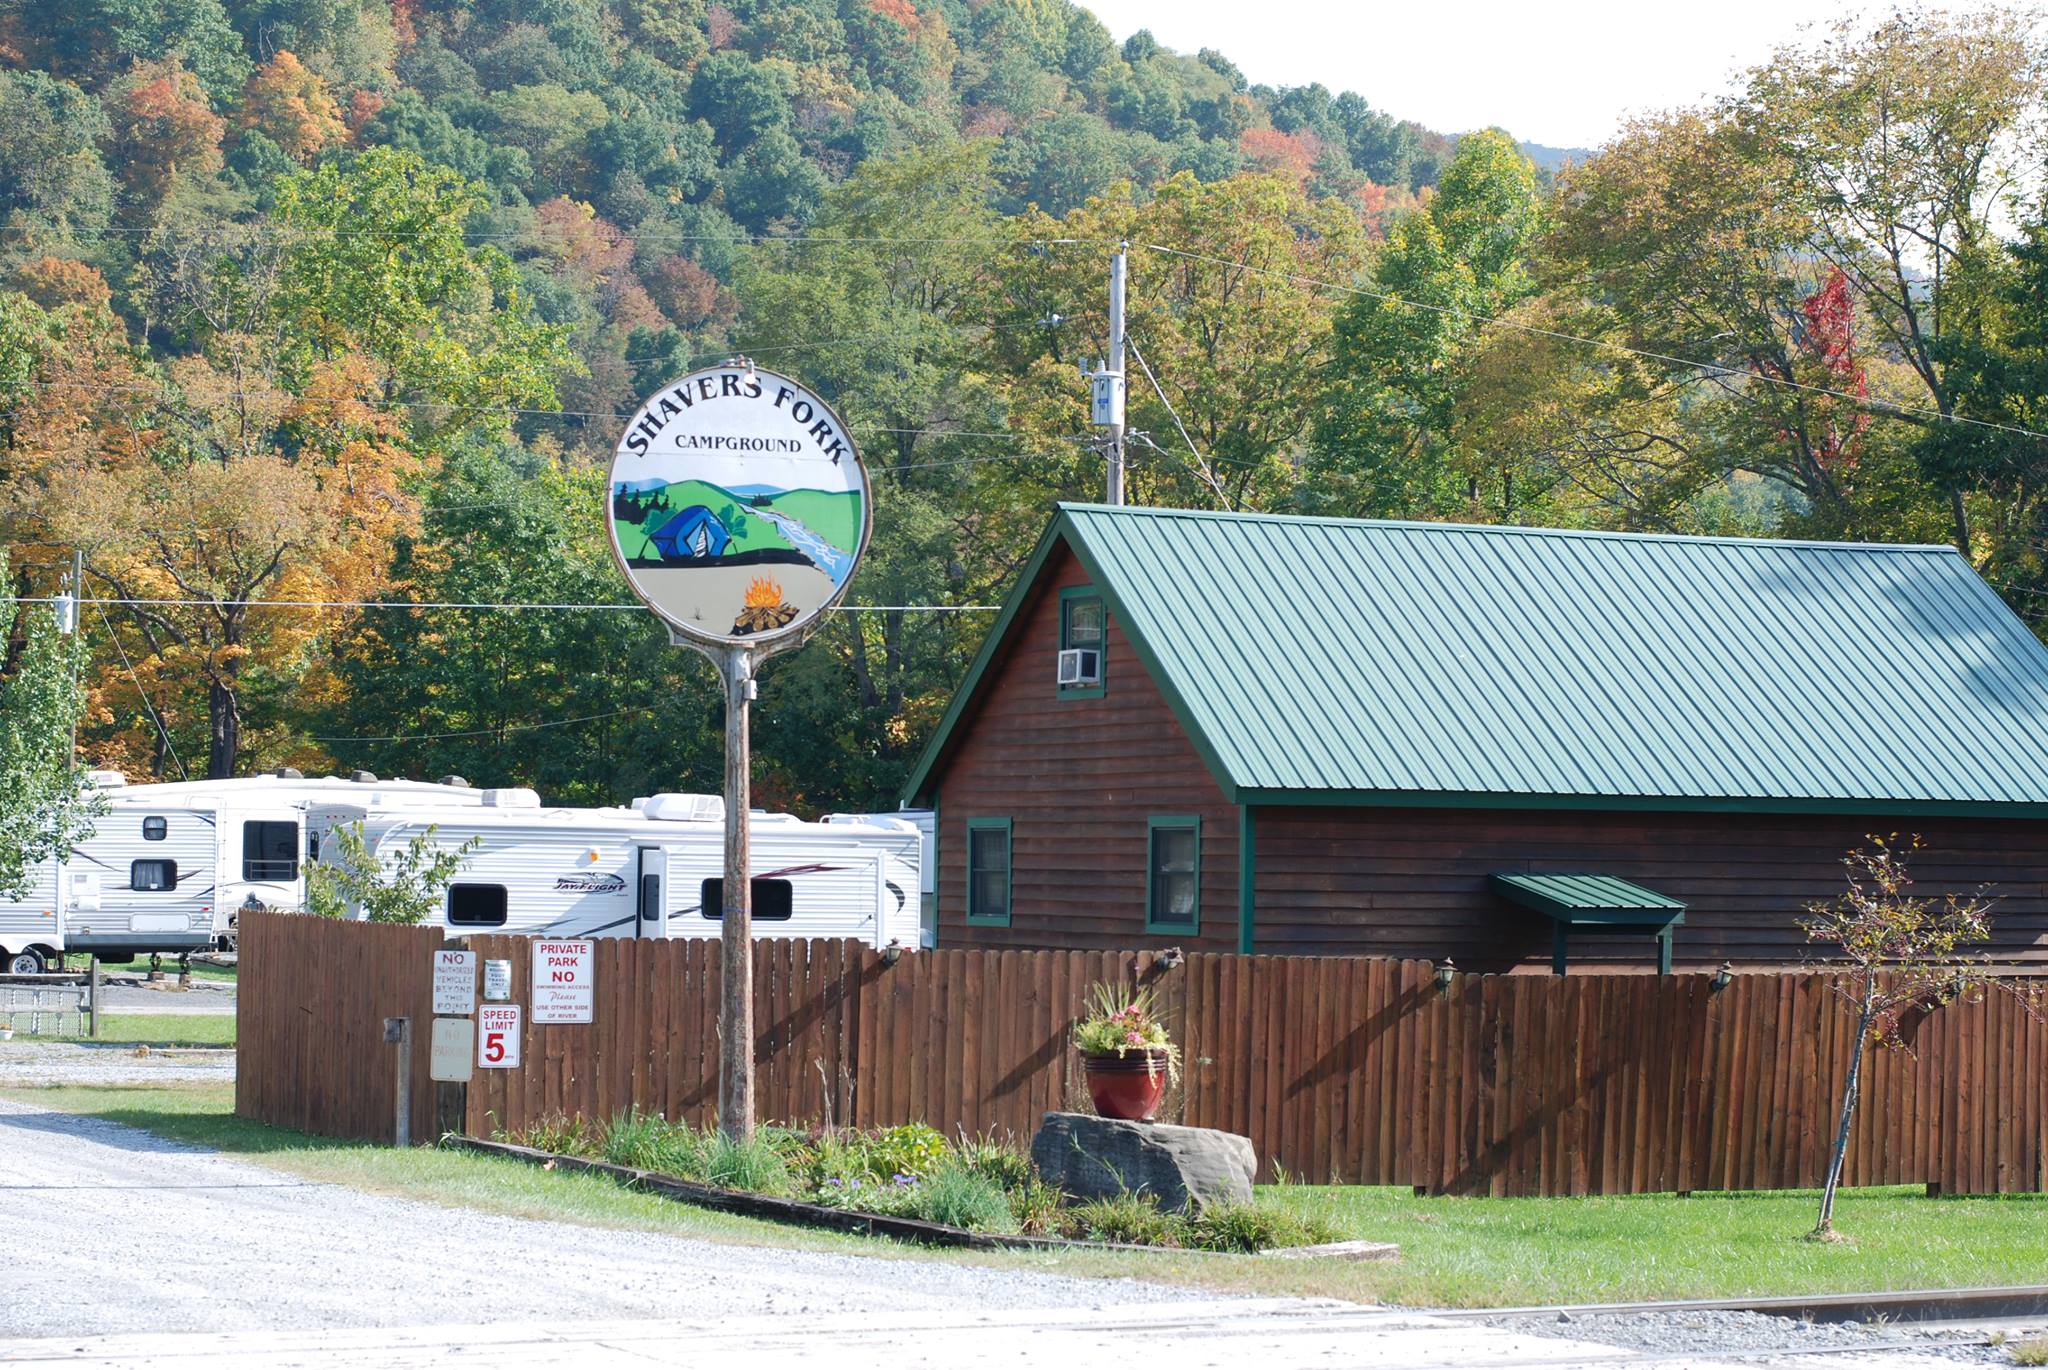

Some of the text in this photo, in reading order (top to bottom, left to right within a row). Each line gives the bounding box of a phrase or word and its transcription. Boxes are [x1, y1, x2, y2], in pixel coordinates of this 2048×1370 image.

[627, 373, 849, 467] SHAVERS FORK
[675, 434, 802, 453] CAMPGROUND
[540, 944, 588, 954] PRIVATE
[443, 954, 464, 964] NO
[548, 957, 578, 967] PARK
[552, 971, 575, 982] NO
[549, 991, 576, 1001] Please
[483, 1010, 516, 1020] SPEED
[485, 1021, 514, 1030] LIMIT
[485, 1033, 504, 1062] 5
